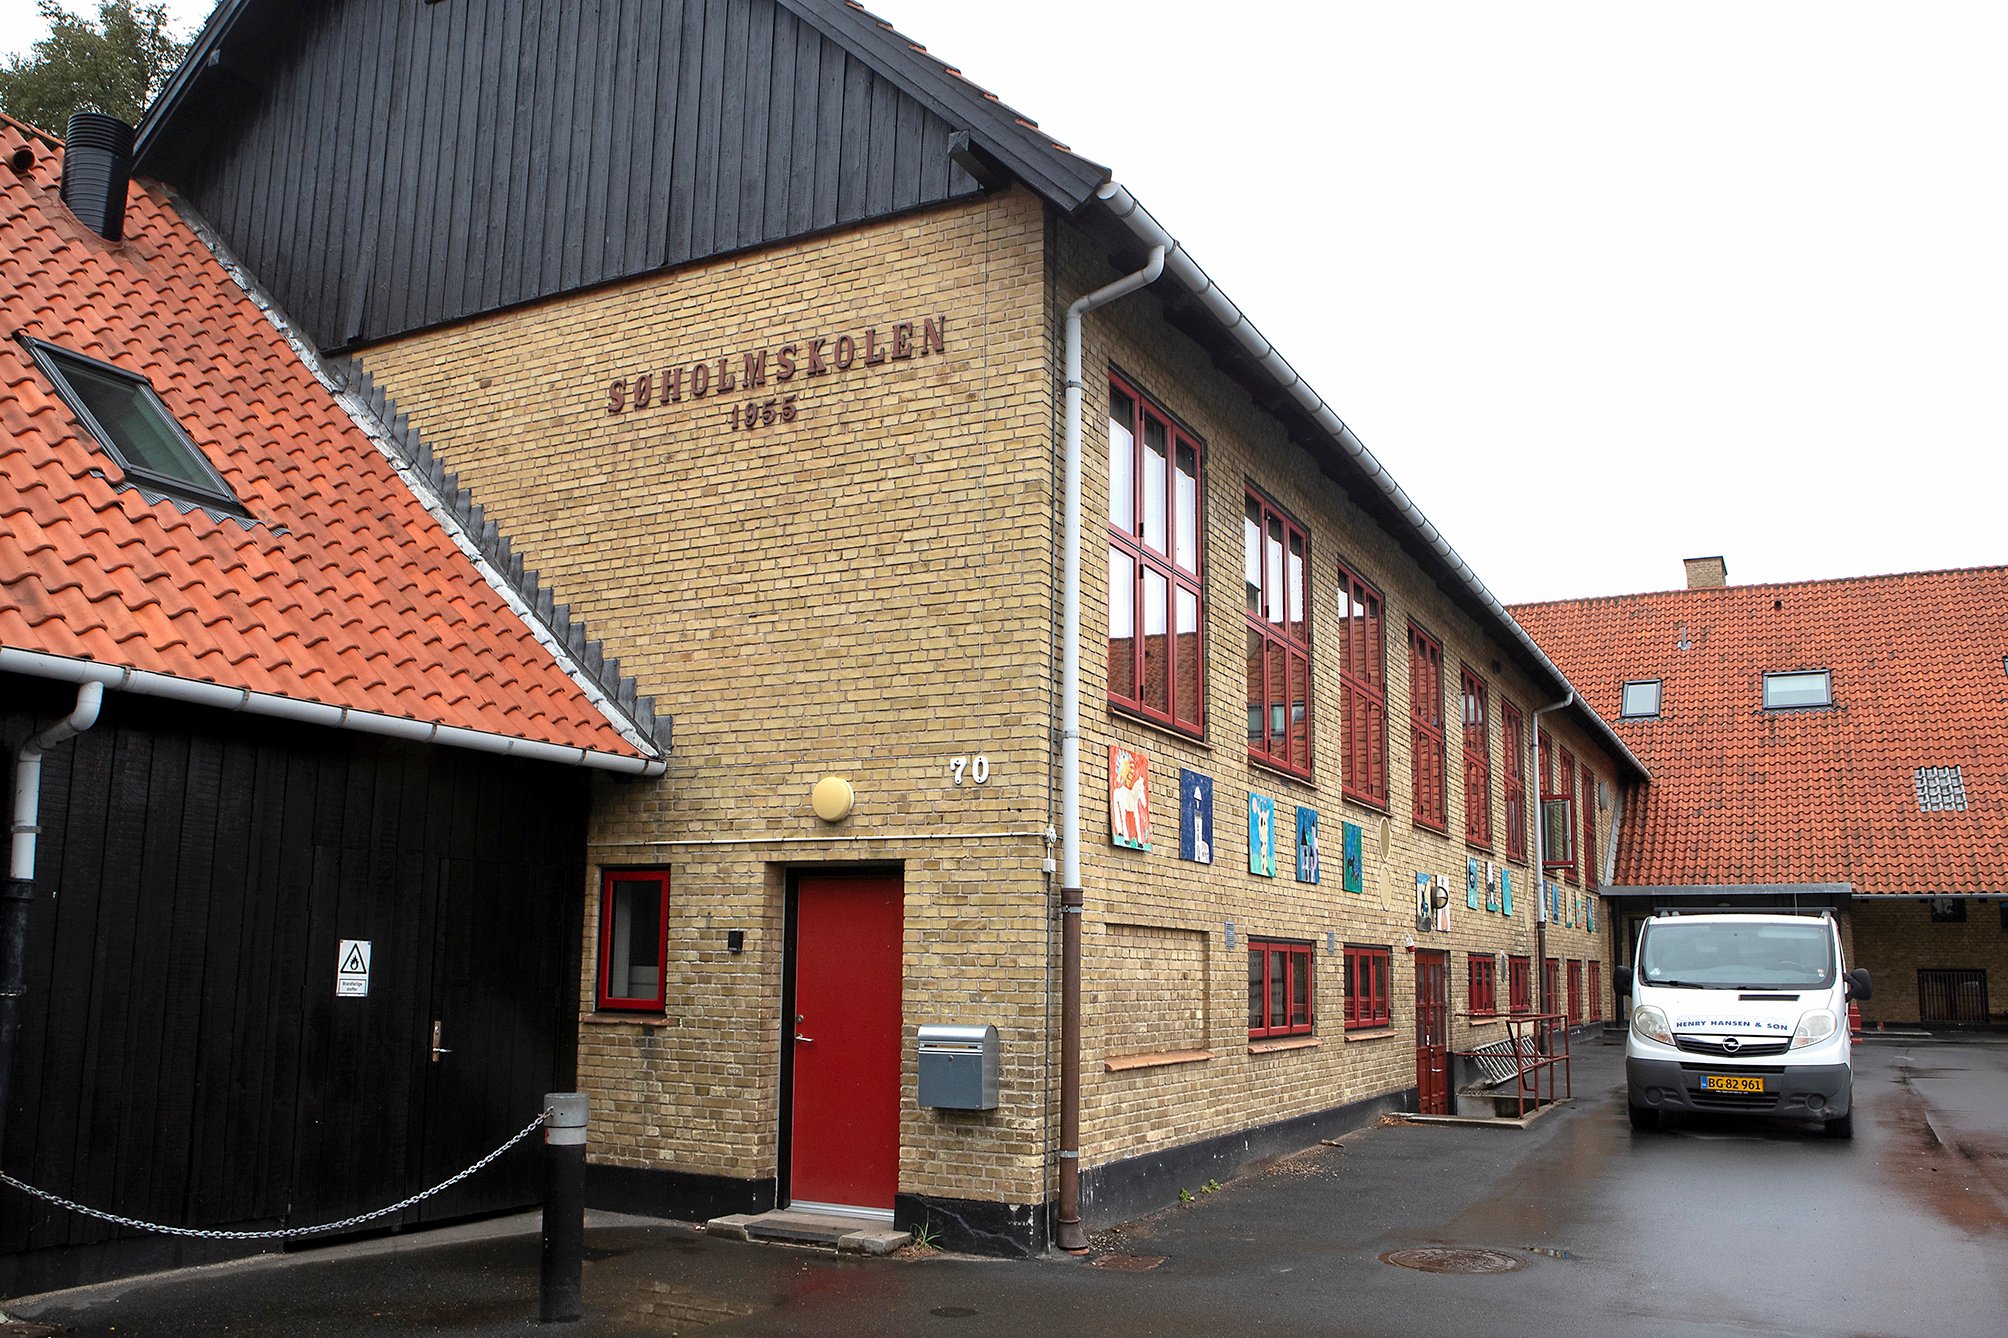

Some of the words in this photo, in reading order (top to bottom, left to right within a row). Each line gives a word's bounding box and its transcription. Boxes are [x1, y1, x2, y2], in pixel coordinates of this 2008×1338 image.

[607, 314, 946, 413] SØHOLMSKOLEN
[731, 394, 798, 430] 1955
[950, 756, 990, 785] 70
[1676, 1020, 1707, 1028] HENRY
[1767, 1023, 1788, 1031] SON
[1708, 1078, 1723, 1088] BG
[1726, 1078, 1739, 1089] 82
[1741, 1079, 1761, 1090] 961
